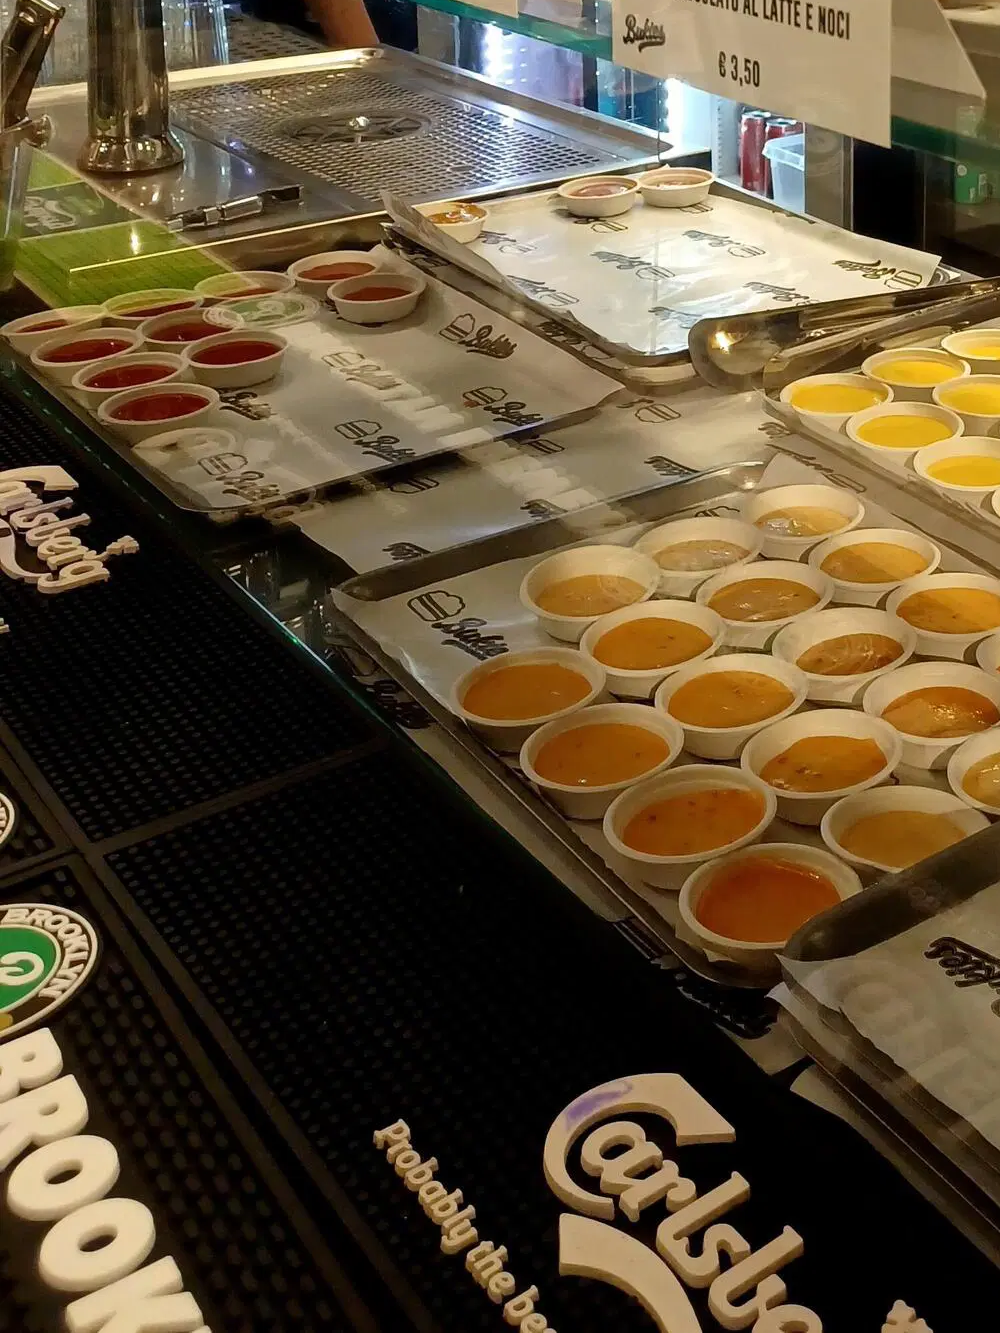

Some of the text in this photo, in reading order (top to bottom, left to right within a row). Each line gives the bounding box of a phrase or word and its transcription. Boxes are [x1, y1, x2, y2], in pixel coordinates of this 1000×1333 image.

[718, 51, 760, 88] € 3,50
[806, 2, 813, 31] E
[818, 5, 850, 40] NOCI
[0, 1027, 213, 1333] BROOK
[373, 1119, 479, 1255] Probably
[465, 1240, 516, 1304] the
